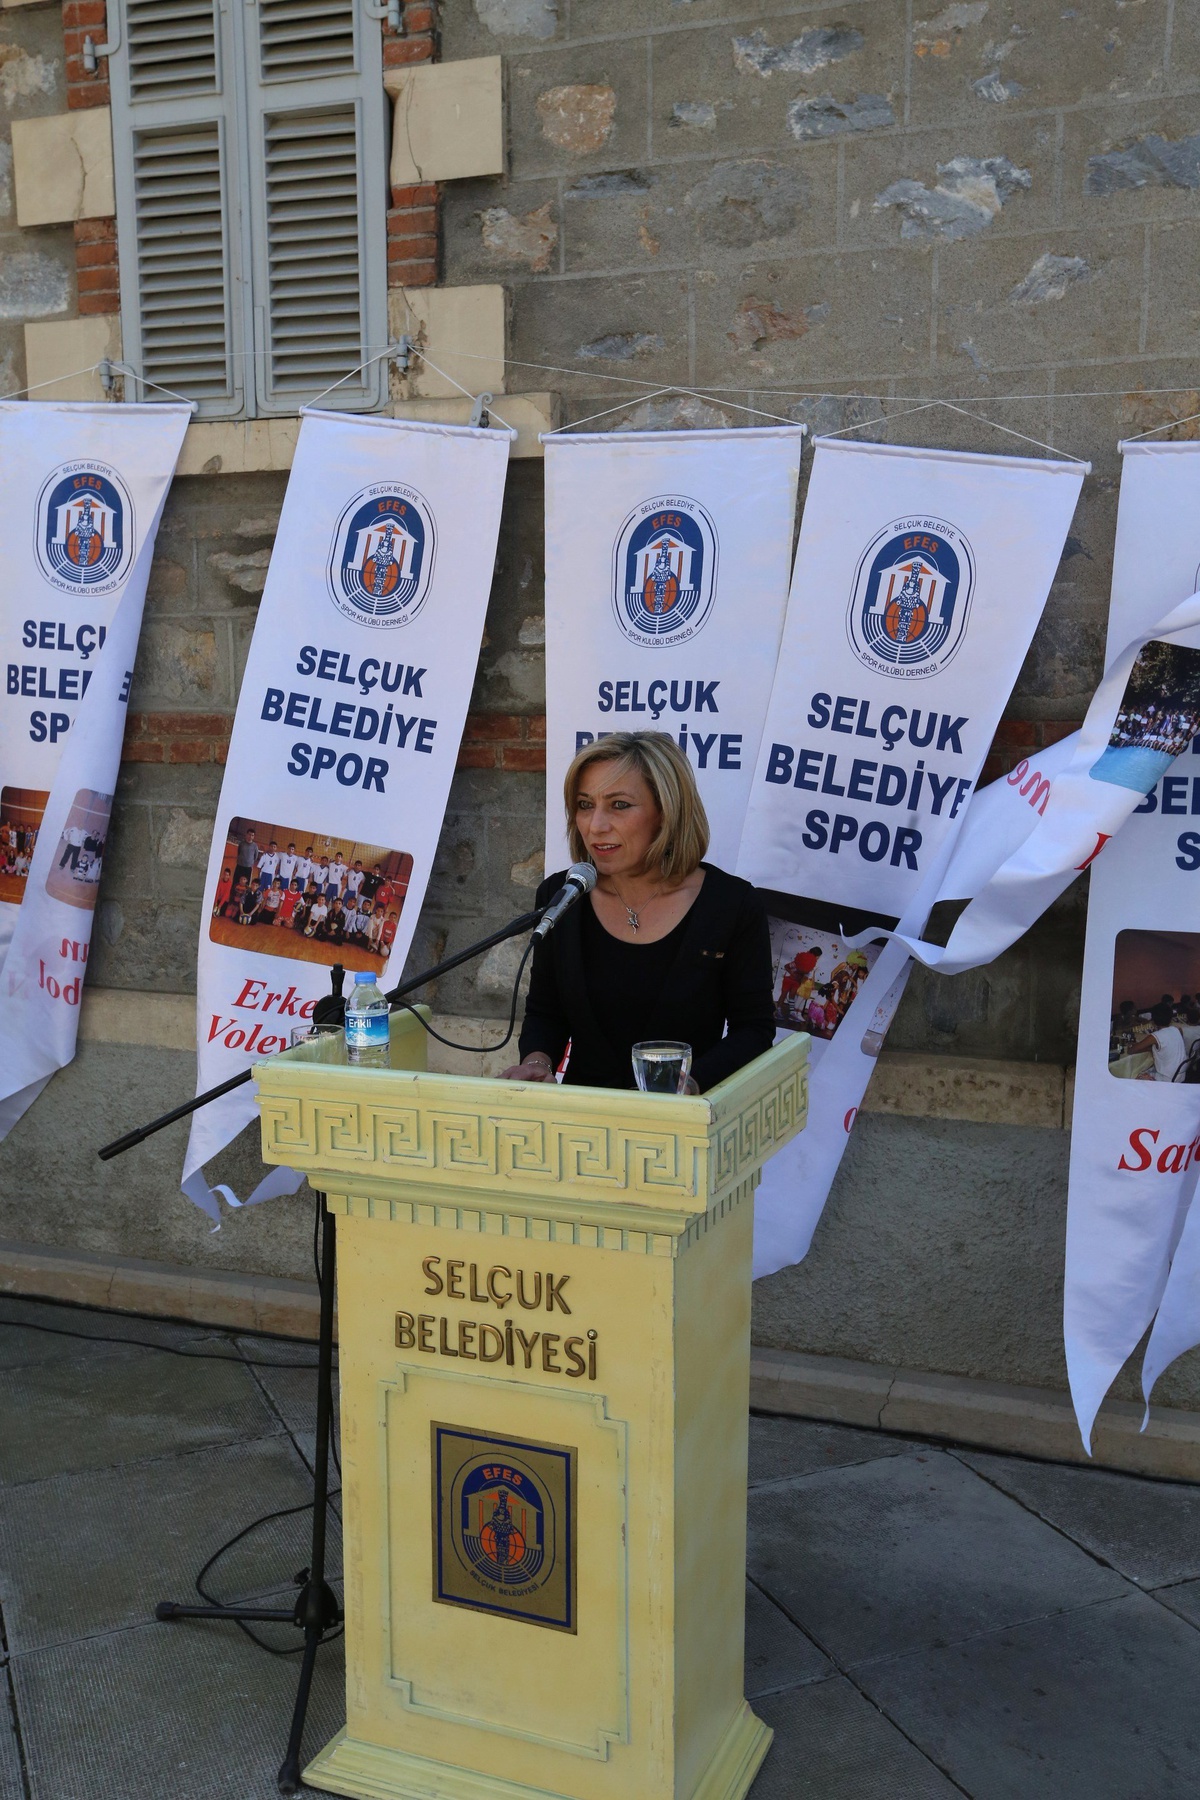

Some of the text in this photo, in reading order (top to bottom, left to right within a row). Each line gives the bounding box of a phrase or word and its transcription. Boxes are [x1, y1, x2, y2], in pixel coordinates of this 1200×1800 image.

[73, 475, 103, 490] EFES
[377, 499, 407, 516] EFES
[652, 513, 682, 530] EFES
[893, 520, 922, 532] SELÇUK
[903, 534, 939, 553] EFES
[341, 604, 357, 618] SPOR
[296, 645, 428, 698] SELÇUK
[861, 653, 879, 668] SPOR
[7, 663, 94, 701] BELE
[597, 679, 721, 720] SELÇUK
[29, 710, 76, 744] SP
[260, 687, 438, 754] BELEDİYE
[807, 692, 970, 754] SELÇUK
[286, 742, 390, 794] SPOR
[765, 742, 973, 820] BELEDİYE
[801, 808, 923, 872] SPOR
[231, 978, 318, 1019] Erke
[348, 1018, 372, 1029] Erikli
[421, 1255, 572, 1315] SELÇUK
[394, 1310, 599, 1381] BELEDİYESİ
[482, 1466, 523, 1486] EFES
